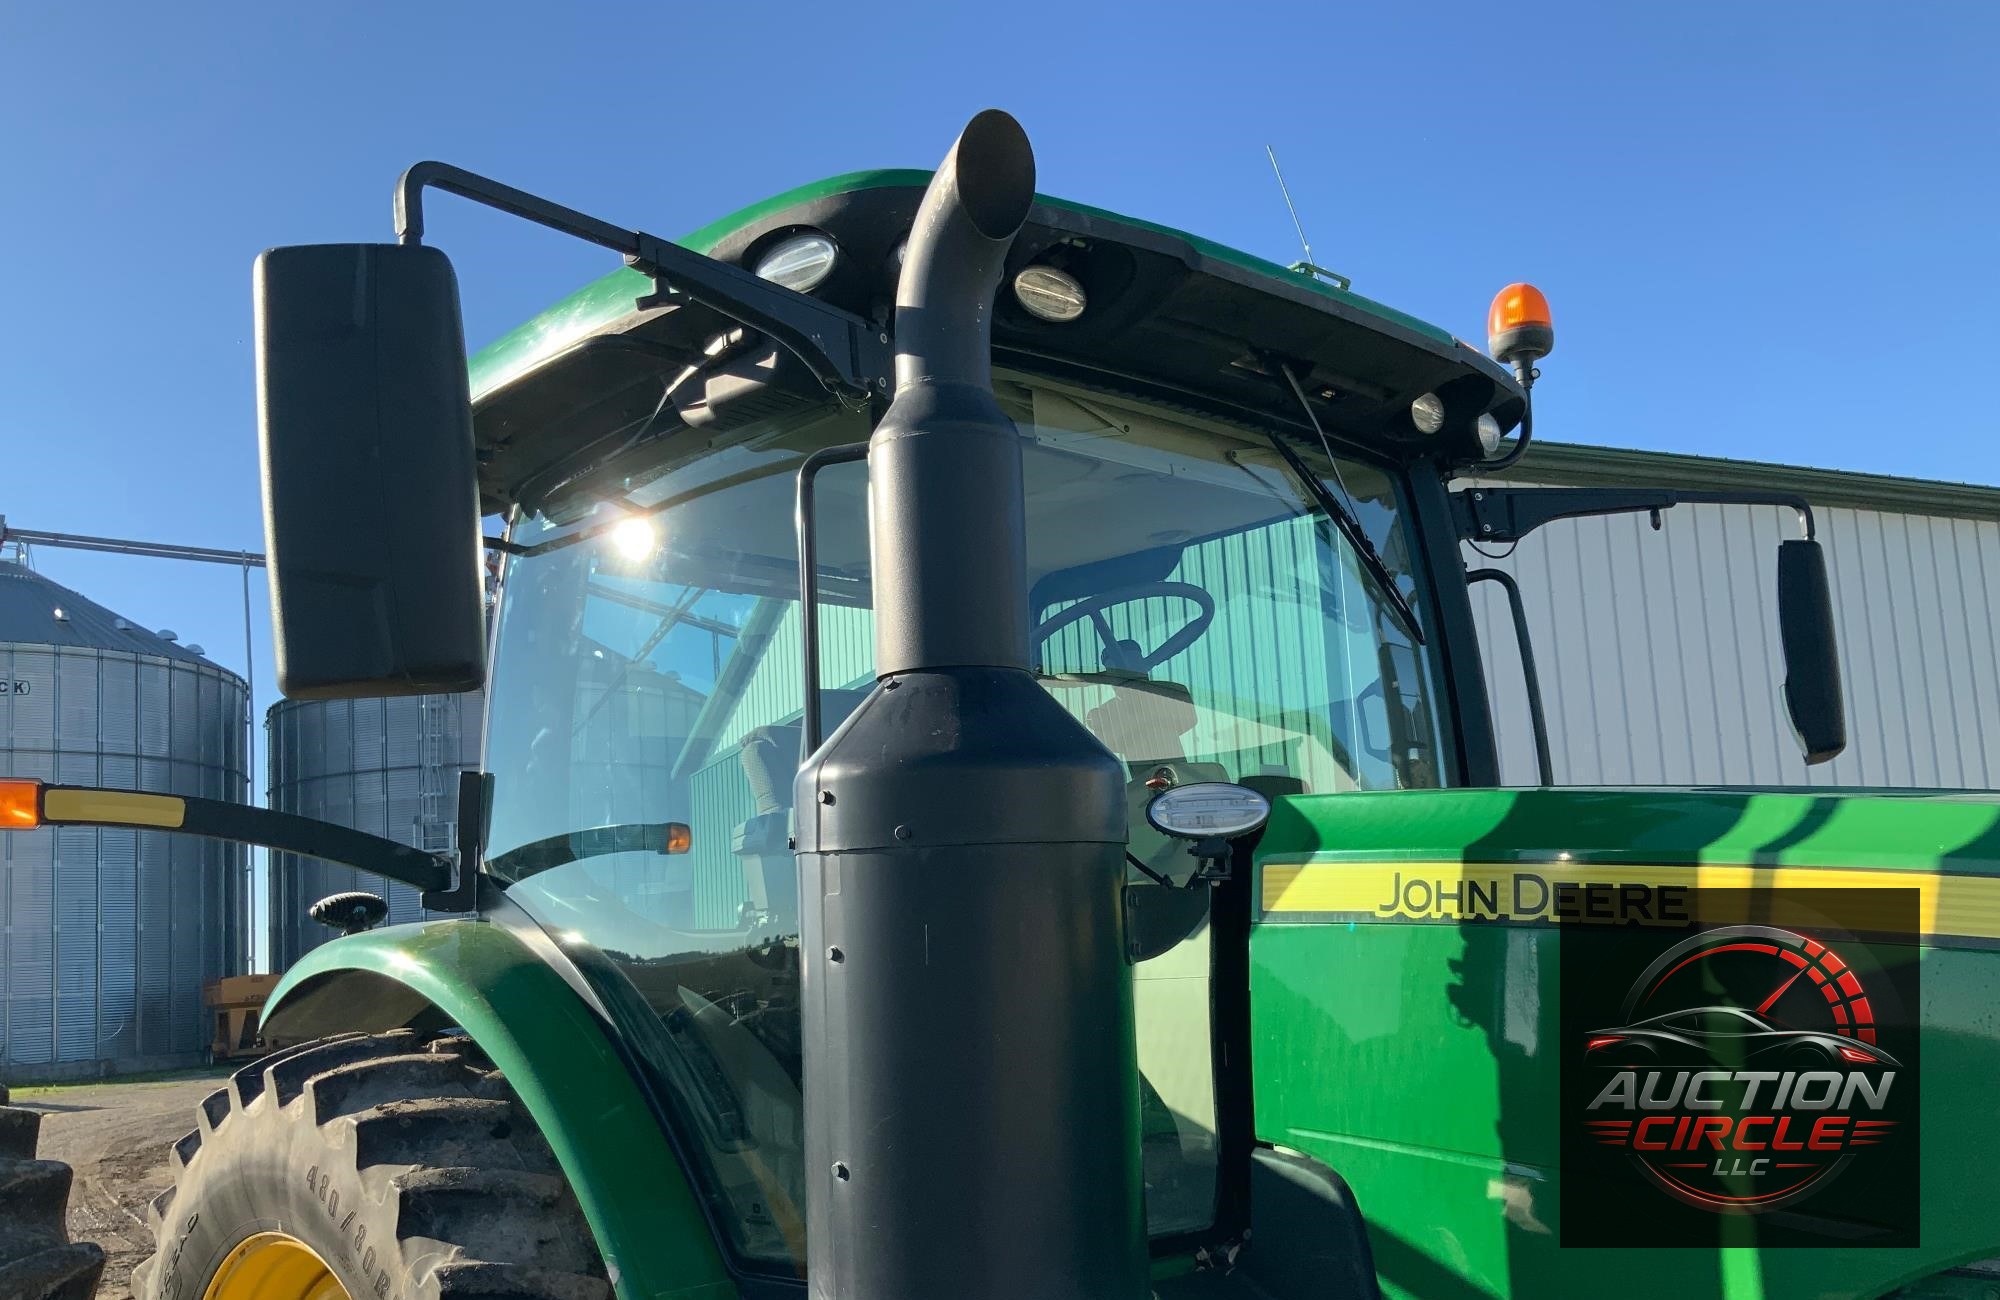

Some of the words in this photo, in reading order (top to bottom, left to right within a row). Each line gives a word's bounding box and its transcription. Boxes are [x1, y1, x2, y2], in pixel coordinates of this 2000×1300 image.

[1379, 872, 1498, 915] JOHN
[1514, 873, 1689, 921] DEERE
[306, 1165, 401, 1300] 480/80R
